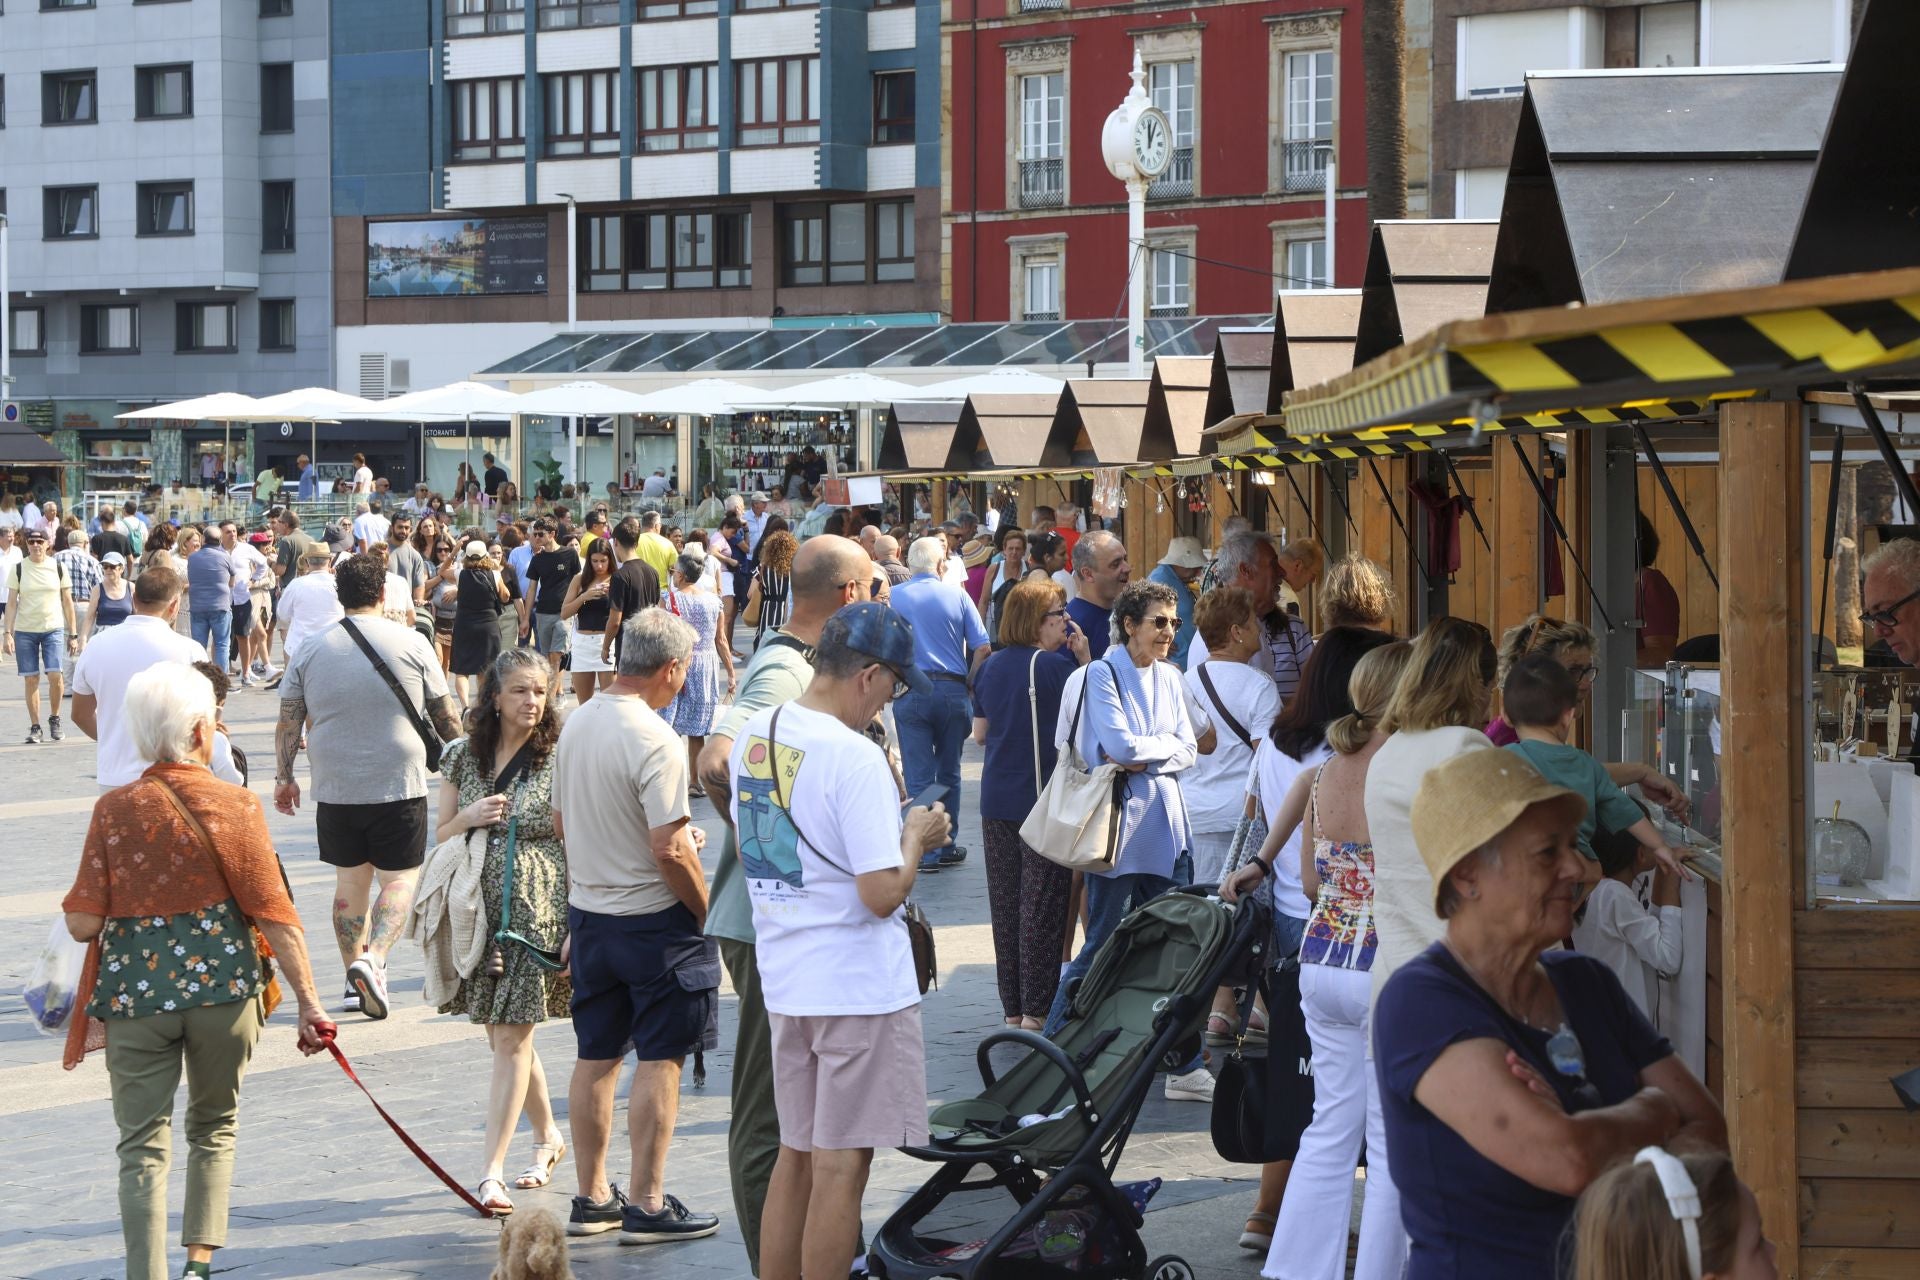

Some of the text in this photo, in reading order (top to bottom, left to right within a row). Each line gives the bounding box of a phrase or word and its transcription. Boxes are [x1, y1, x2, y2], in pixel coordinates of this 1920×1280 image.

[489, 231, 496, 242] 4
[790, 750, 799, 762] 19
[784, 764, 794, 777] 76
